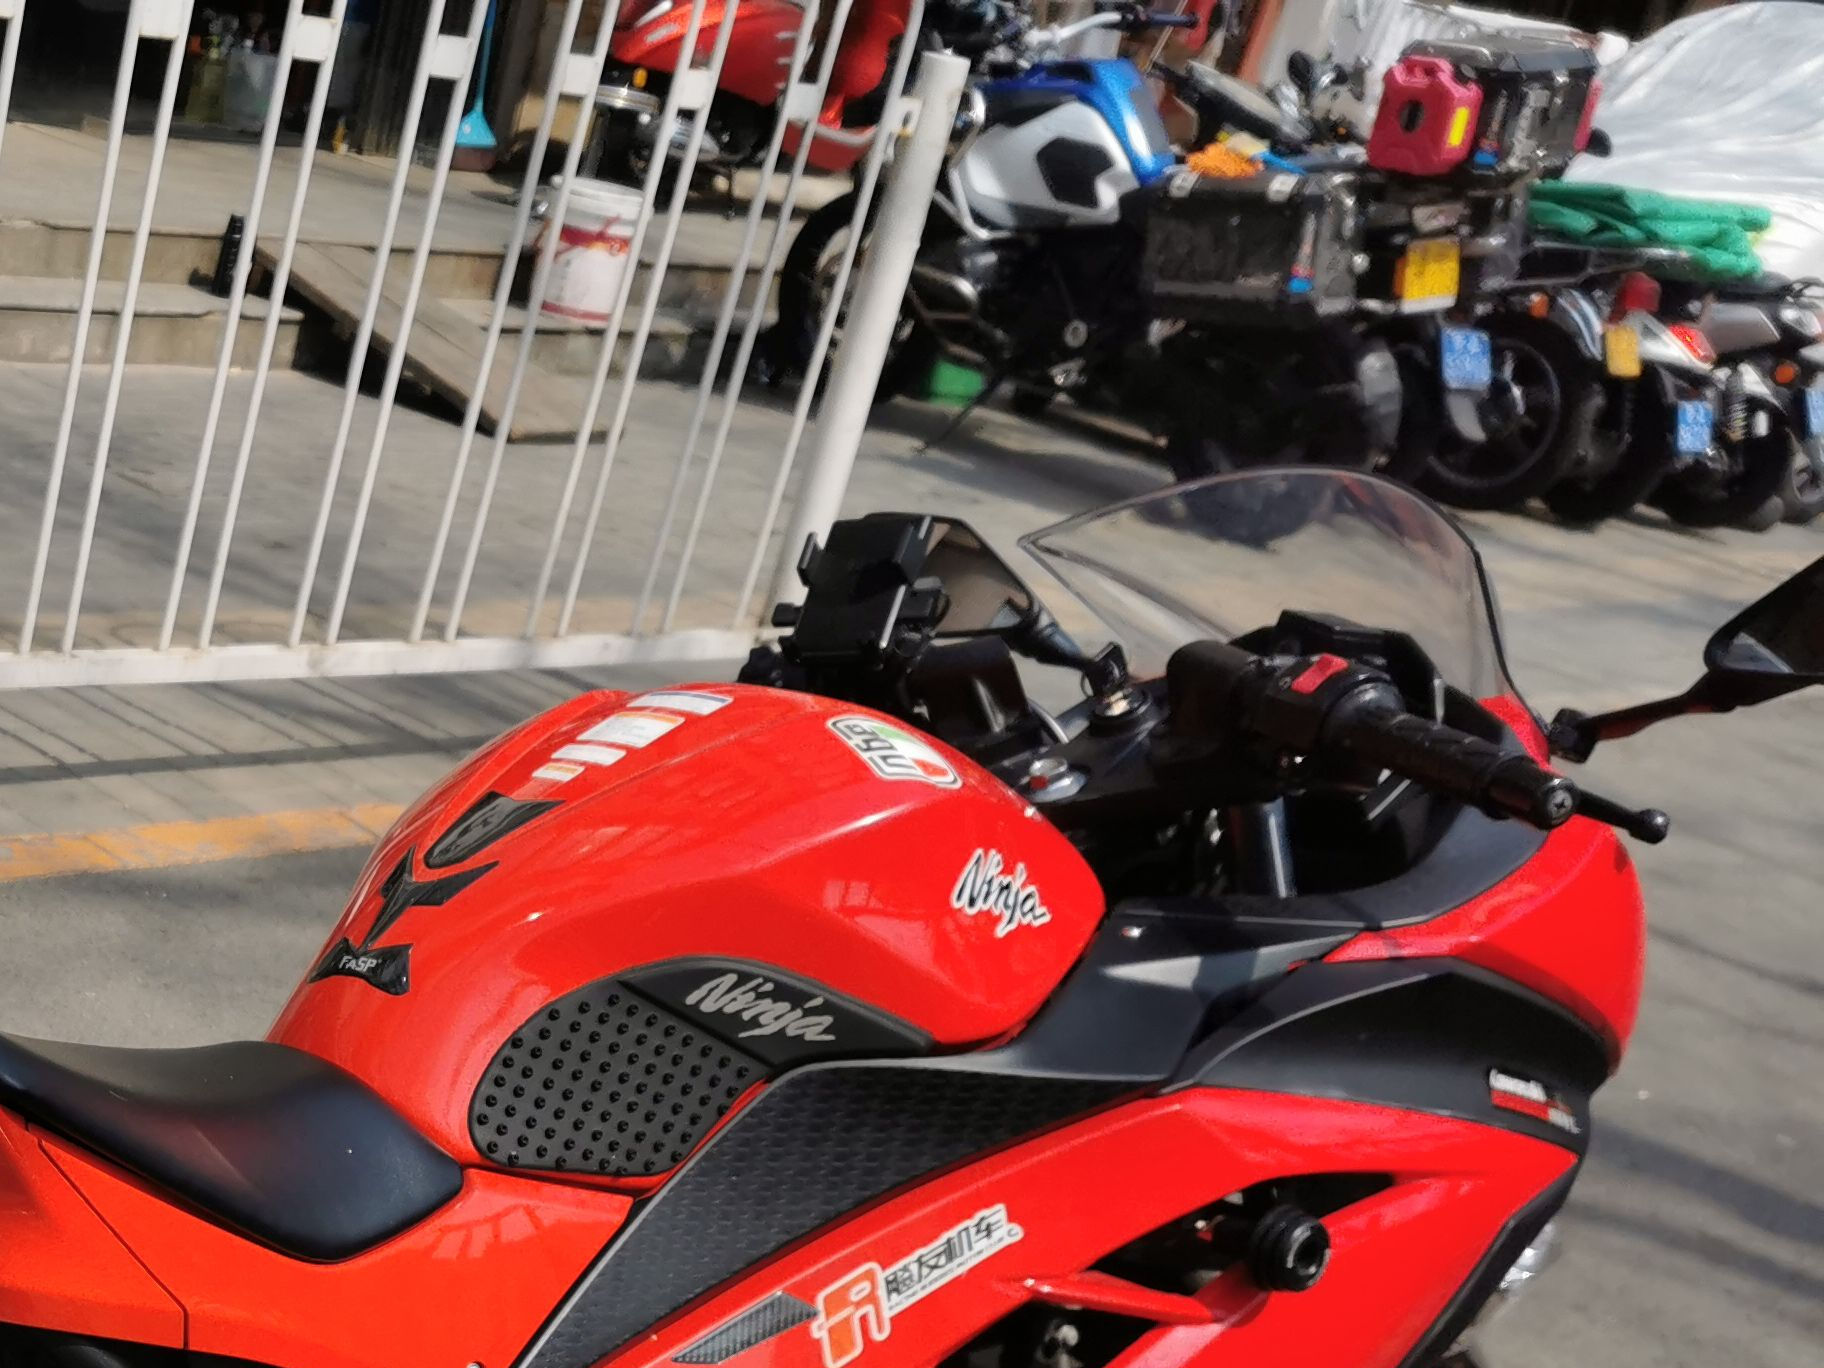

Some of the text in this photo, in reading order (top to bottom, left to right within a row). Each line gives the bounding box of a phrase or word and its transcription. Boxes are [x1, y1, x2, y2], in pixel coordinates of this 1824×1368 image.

[952, 849, 1051, 938] Ninja
[339, 955, 377, 973] FASP
[685, 973, 836, 1040] Ninja
